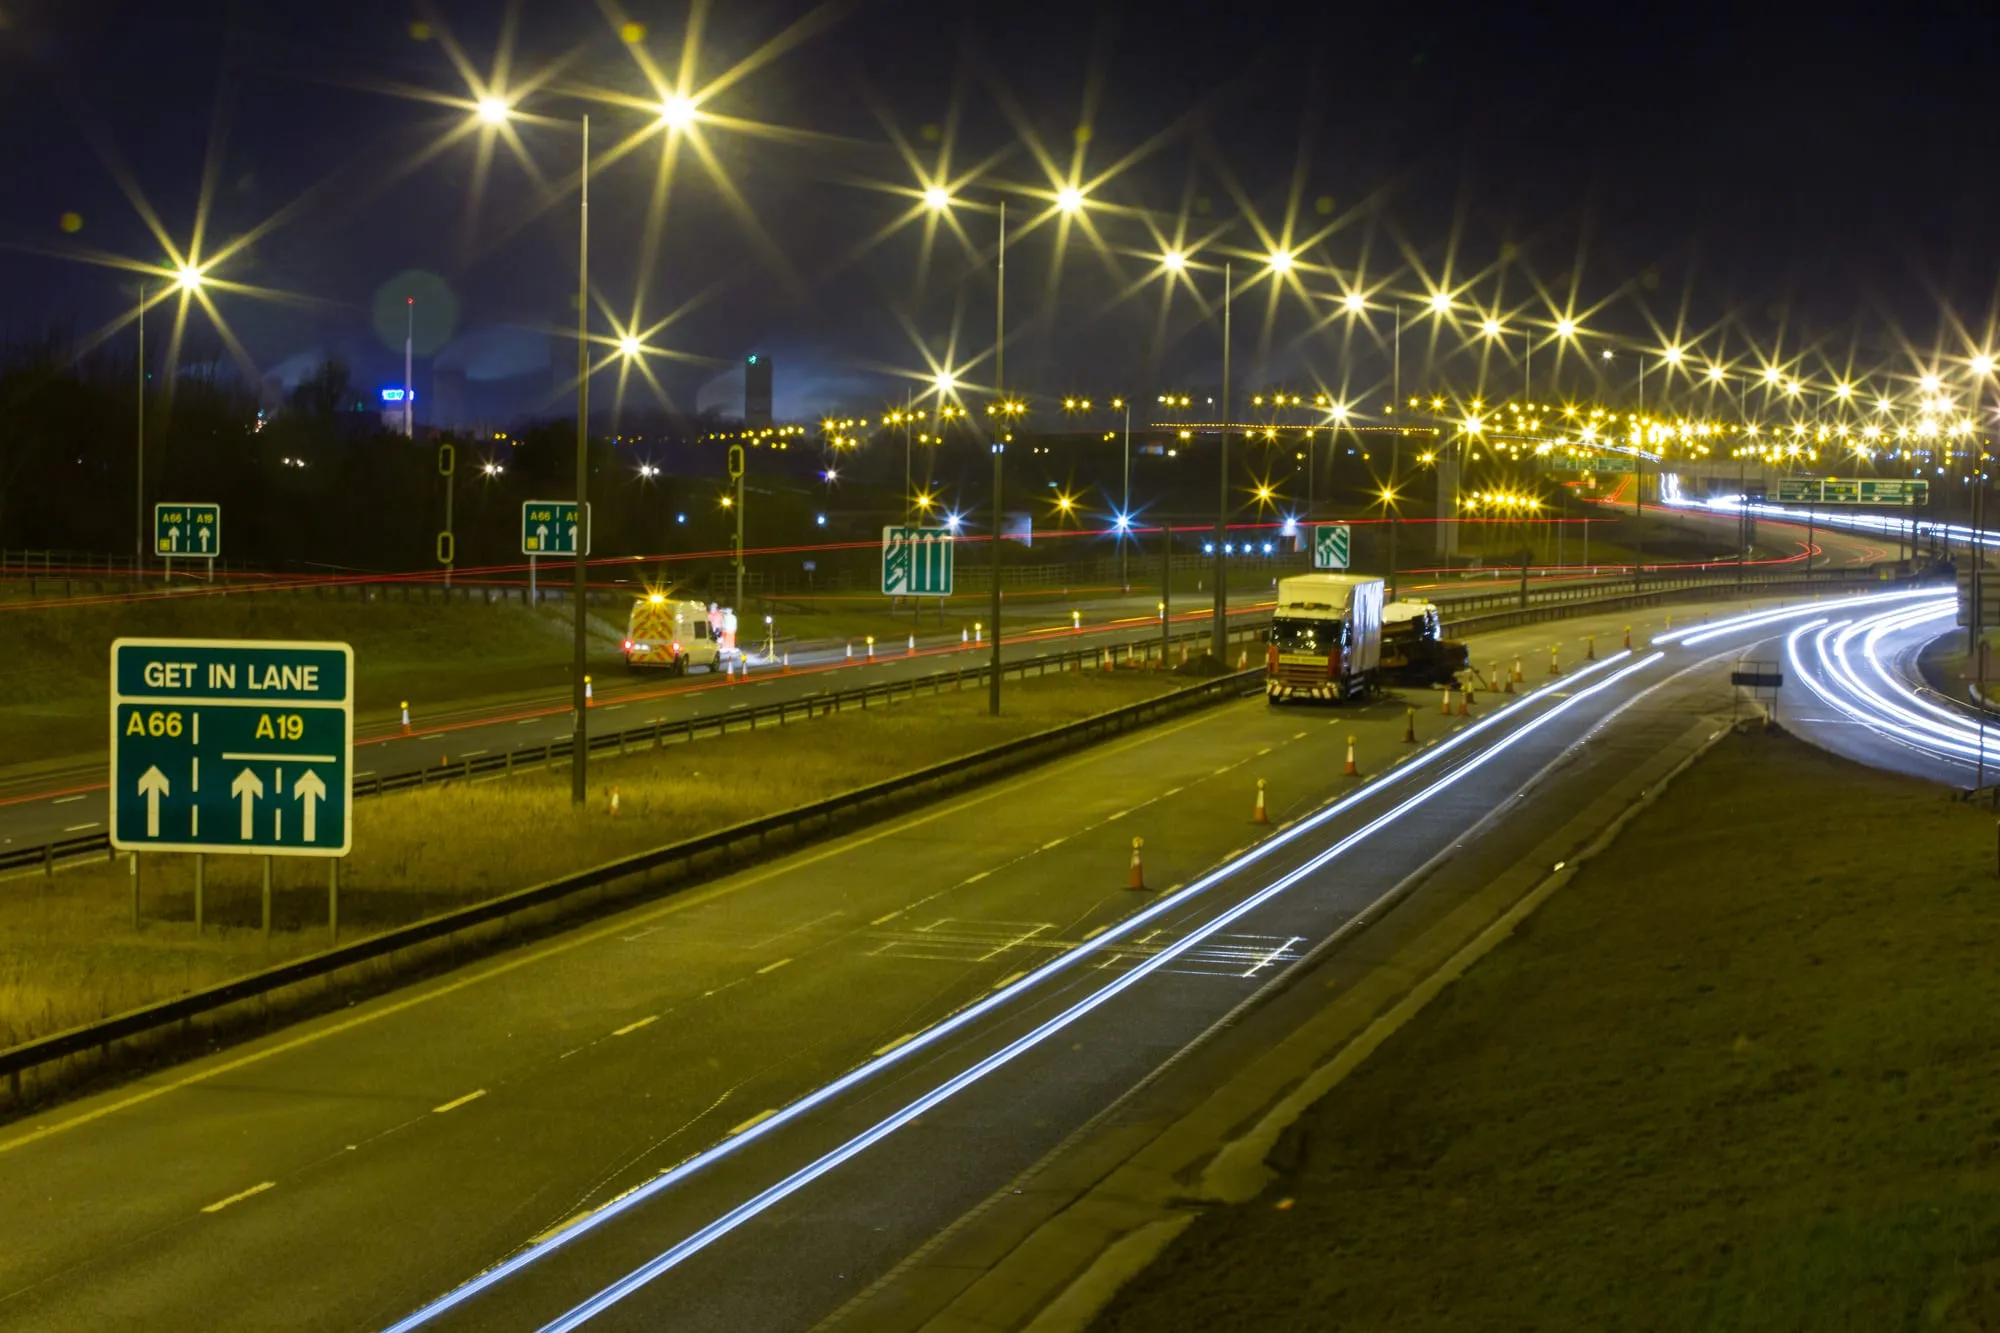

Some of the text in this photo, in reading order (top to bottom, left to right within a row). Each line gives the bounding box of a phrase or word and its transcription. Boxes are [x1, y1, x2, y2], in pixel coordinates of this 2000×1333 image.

[162, 512, 182, 524] A66
[197, 513, 213, 524] A19
[531, 510, 552, 521] A66
[566, 512, 579, 522] A1
[143, 661, 320, 692] GET IN LANE
[126, 711, 183, 738] A66
[255, 713, 304, 741] A19
